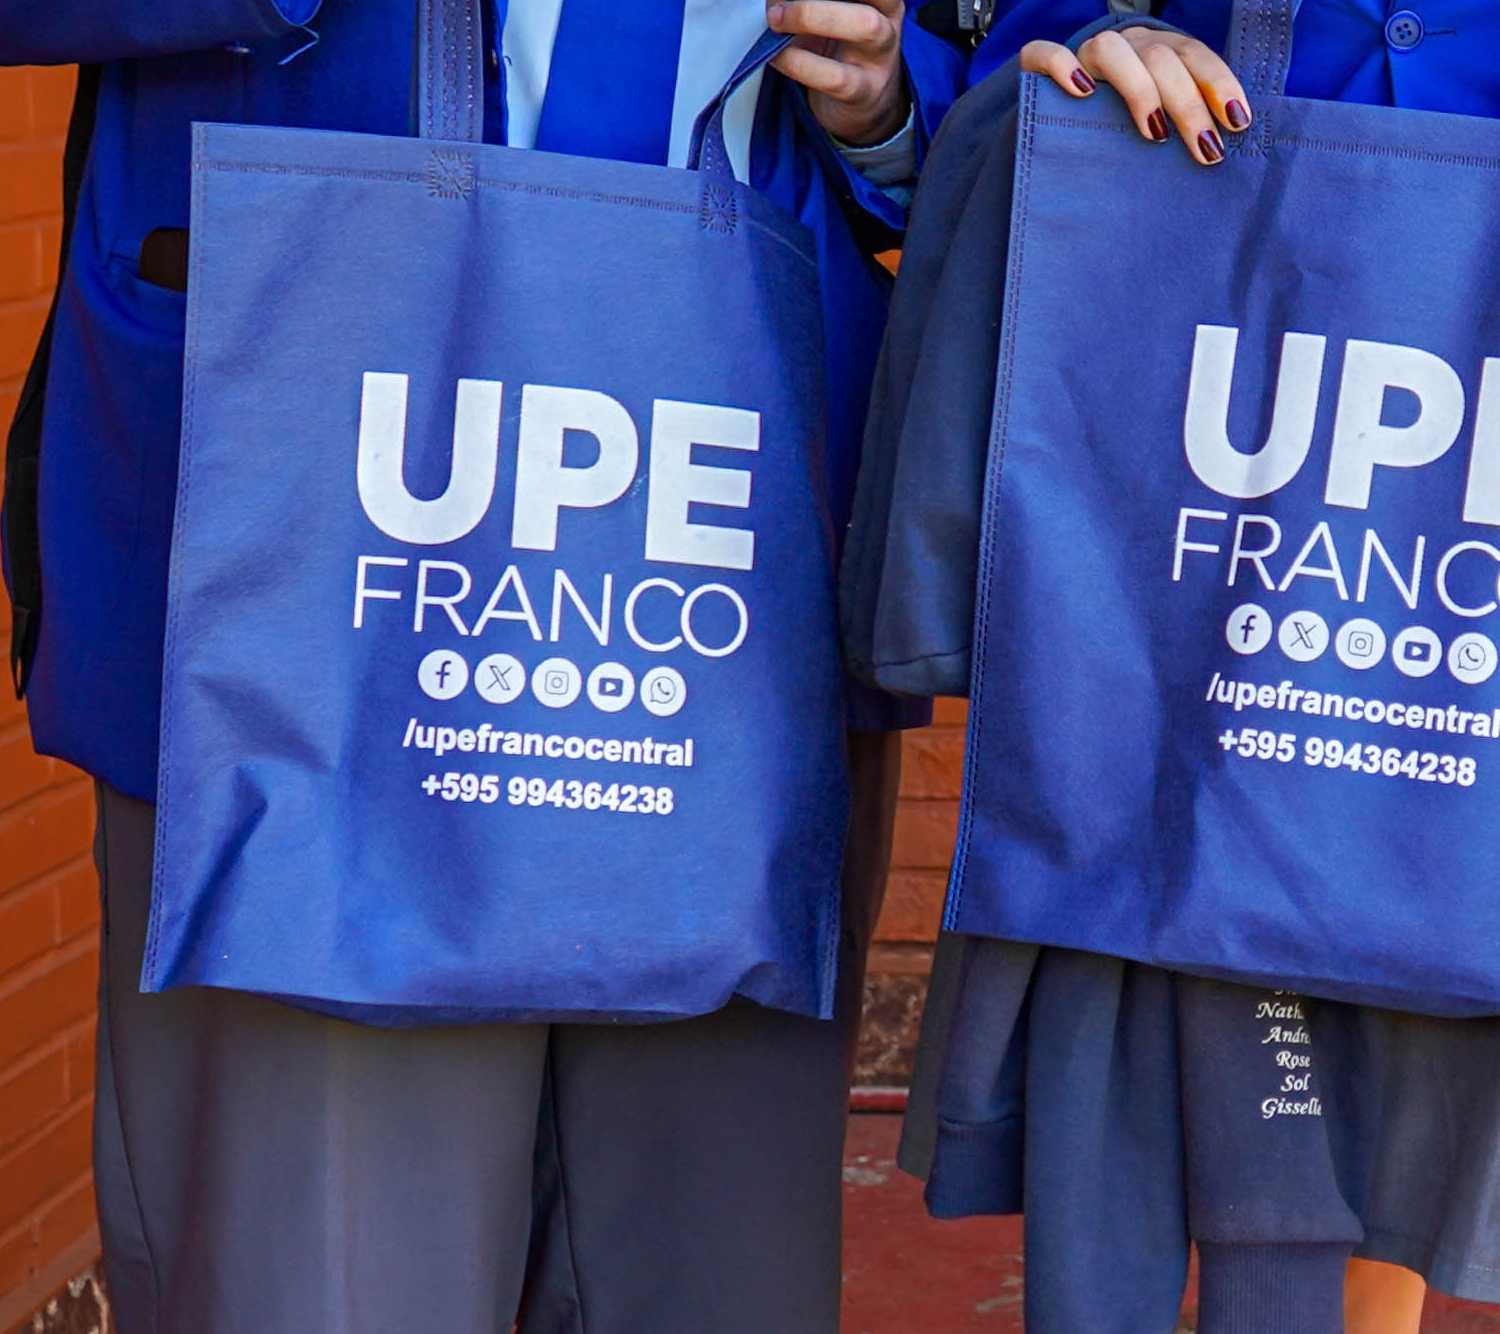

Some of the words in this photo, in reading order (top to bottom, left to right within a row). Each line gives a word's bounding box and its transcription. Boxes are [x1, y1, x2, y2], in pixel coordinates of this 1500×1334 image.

[357, 372, 761, 571] UPE
[354, 556, 749, 658] FRANCO
[402, 717, 695, 768] /upefrancocentral
[1218, 727, 1297, 764] +595
[1303, 736, 1477, 788] 994364238
[421, 772, 500, 804] +595
[507, 776, 674, 816] 994364238
[1275, 1050, 1311, 1070] Rose
[1280, 1073, 1311, 1092] Sol
